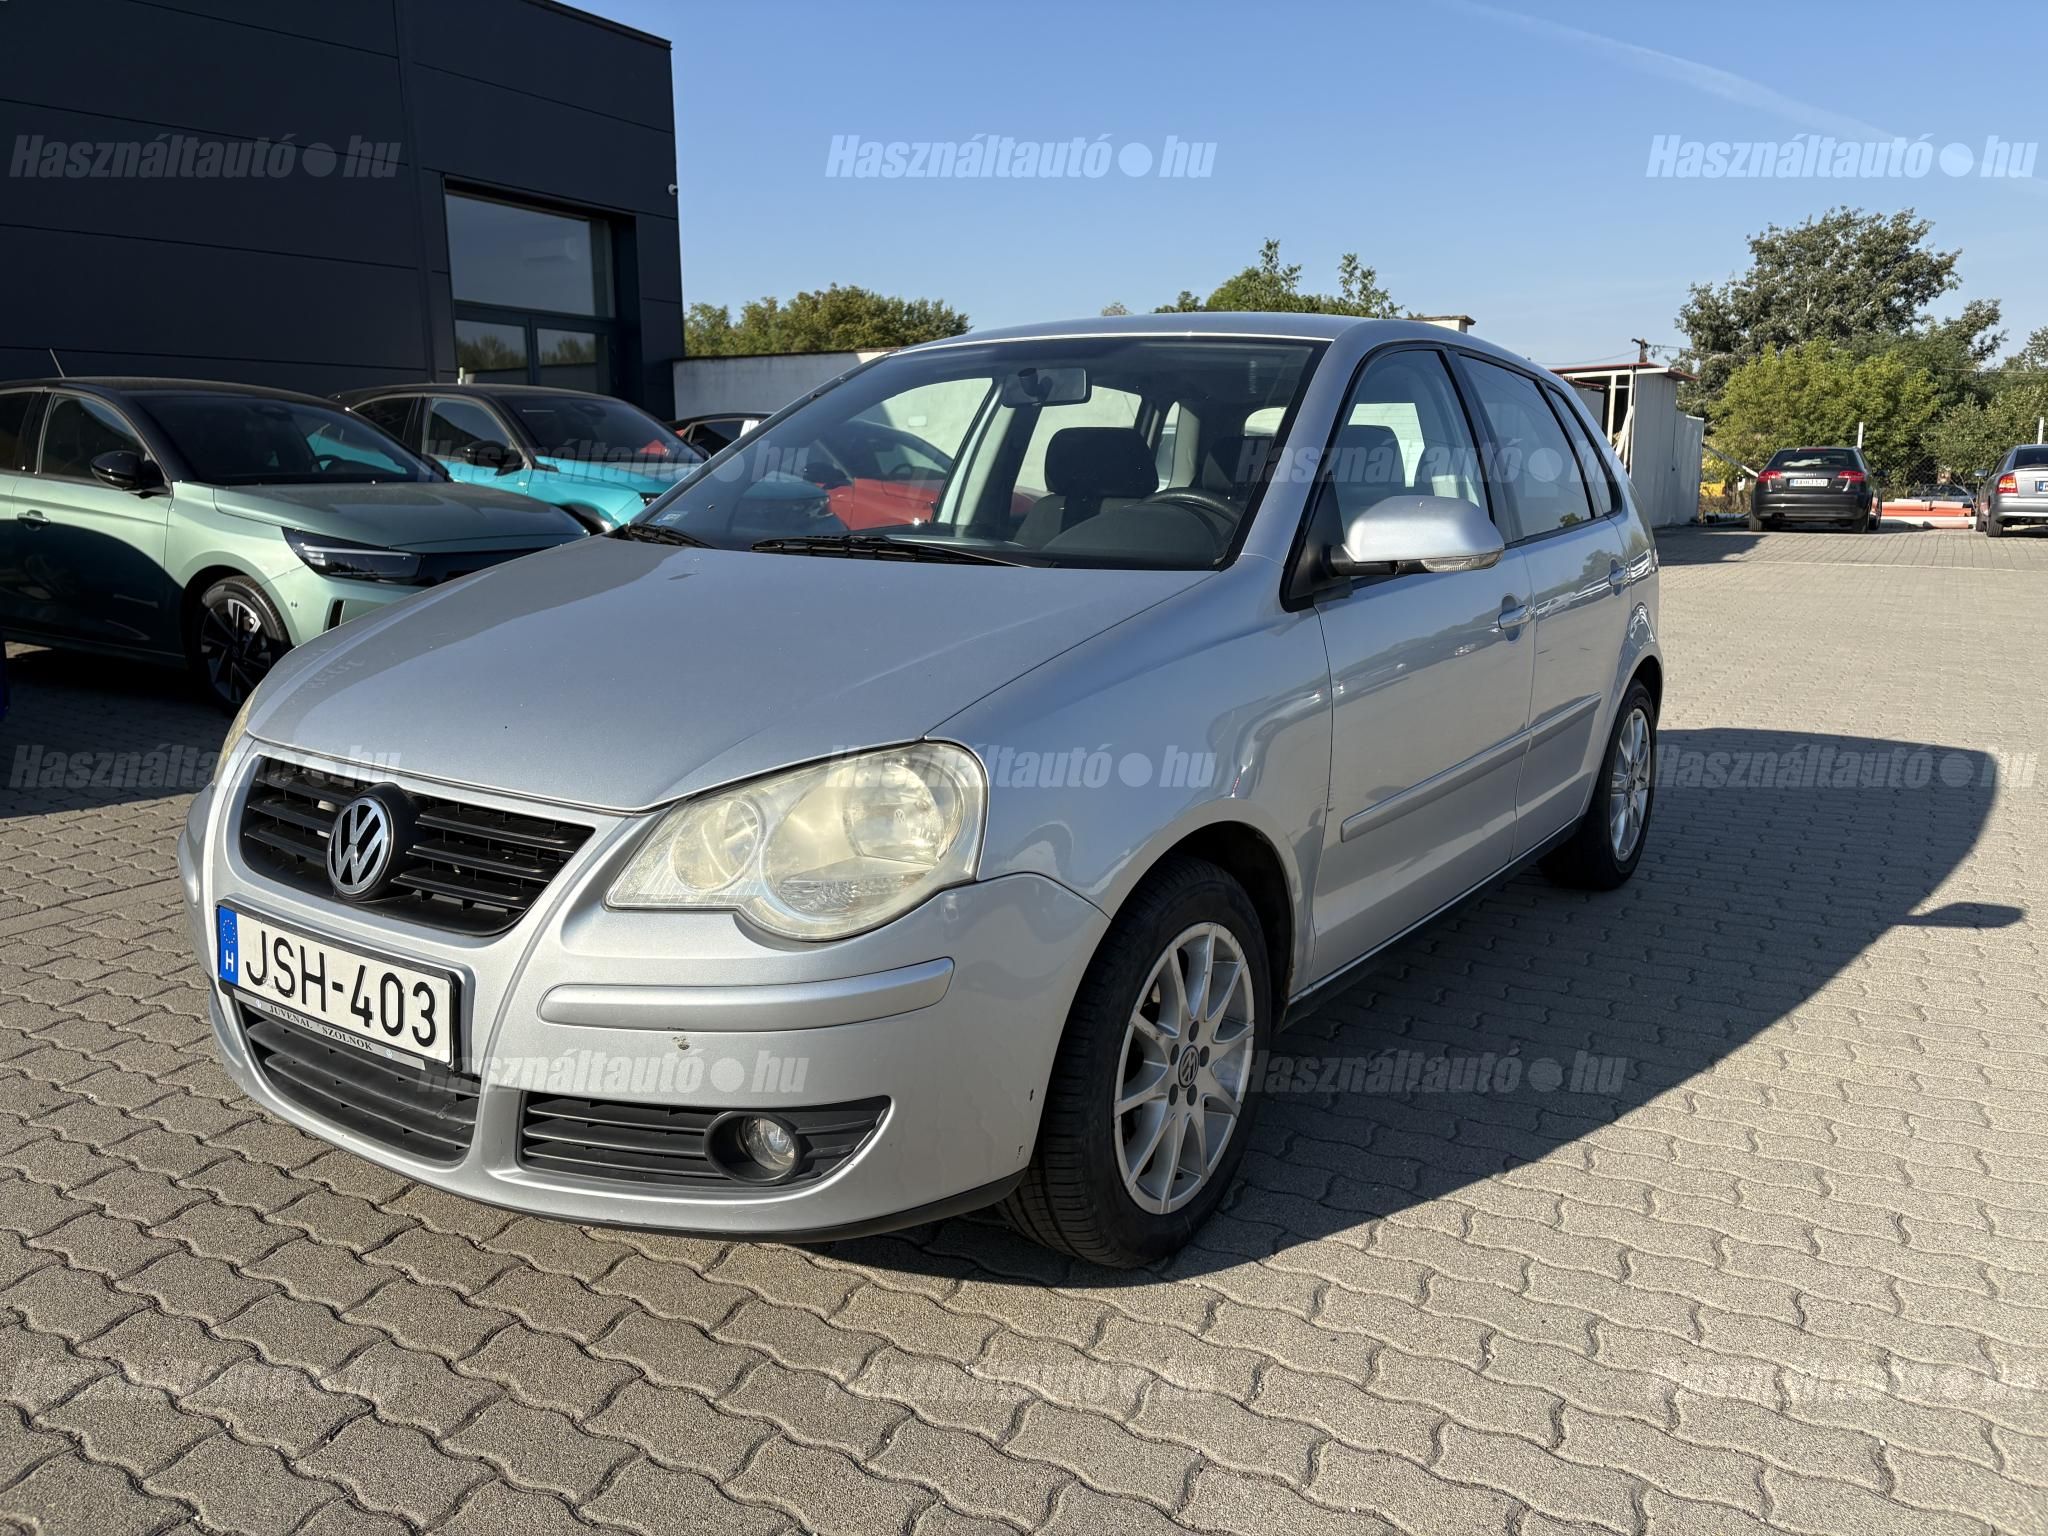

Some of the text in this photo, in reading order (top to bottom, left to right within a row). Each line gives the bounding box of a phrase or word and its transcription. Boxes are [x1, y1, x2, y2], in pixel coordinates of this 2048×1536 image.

[225, 930, 437, 1048] H JSH-403
[269, 1005, 374, 1051] JUVENAL SZOLNOK
